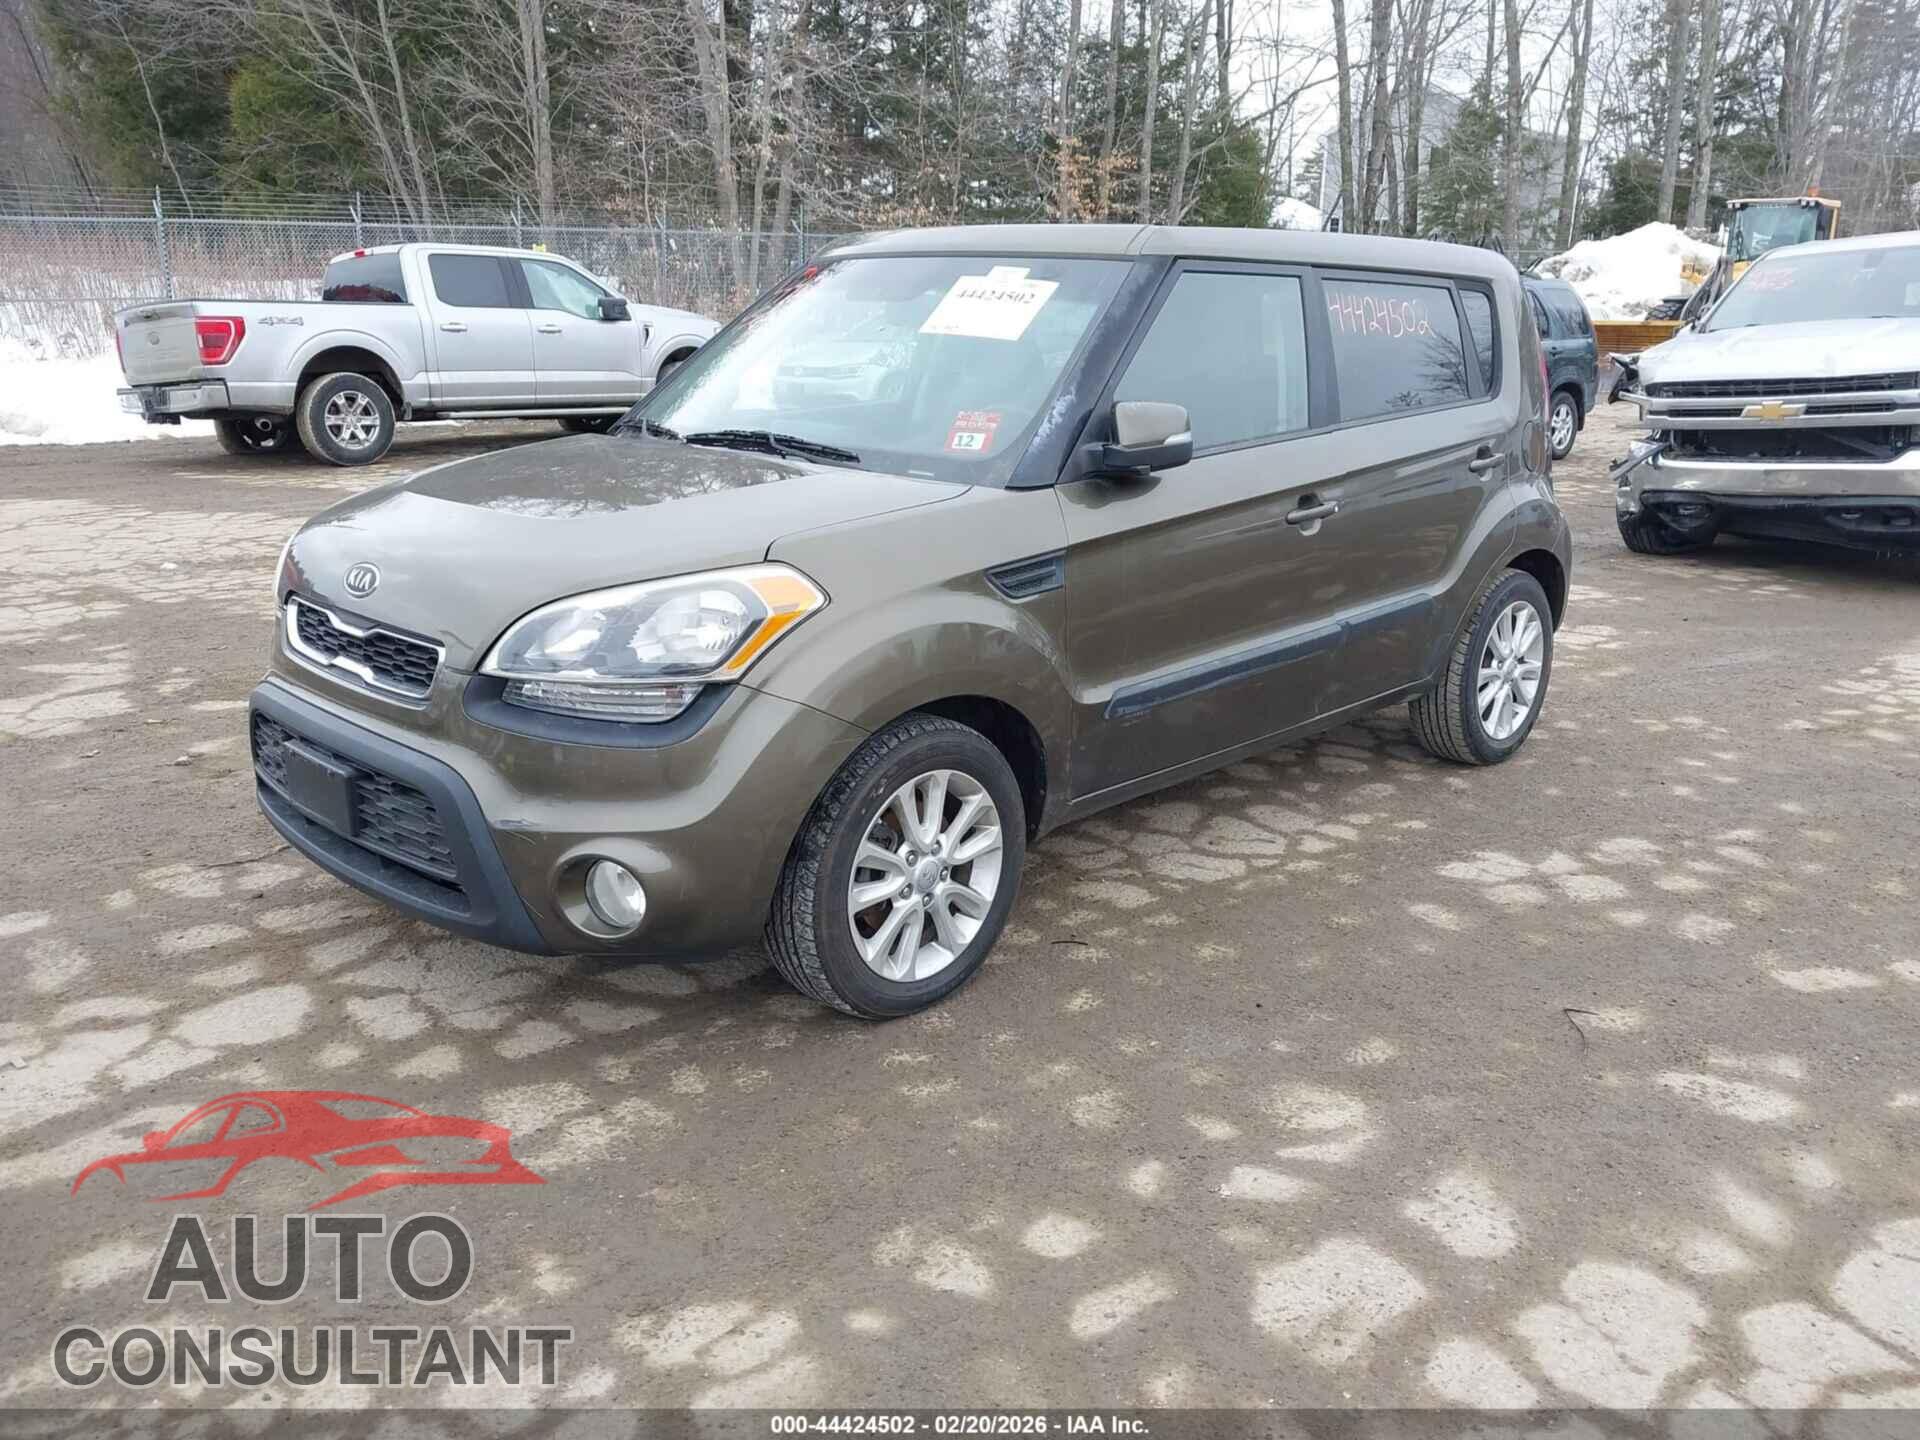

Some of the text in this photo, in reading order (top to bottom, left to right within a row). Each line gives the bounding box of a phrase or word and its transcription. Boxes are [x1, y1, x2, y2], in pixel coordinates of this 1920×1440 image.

[955, 287, 1036, 305] 44424502
[1328, 291, 1437, 338] 44424502
[955, 434, 975, 448] 12
[347, 568, 372, 590] KIA
